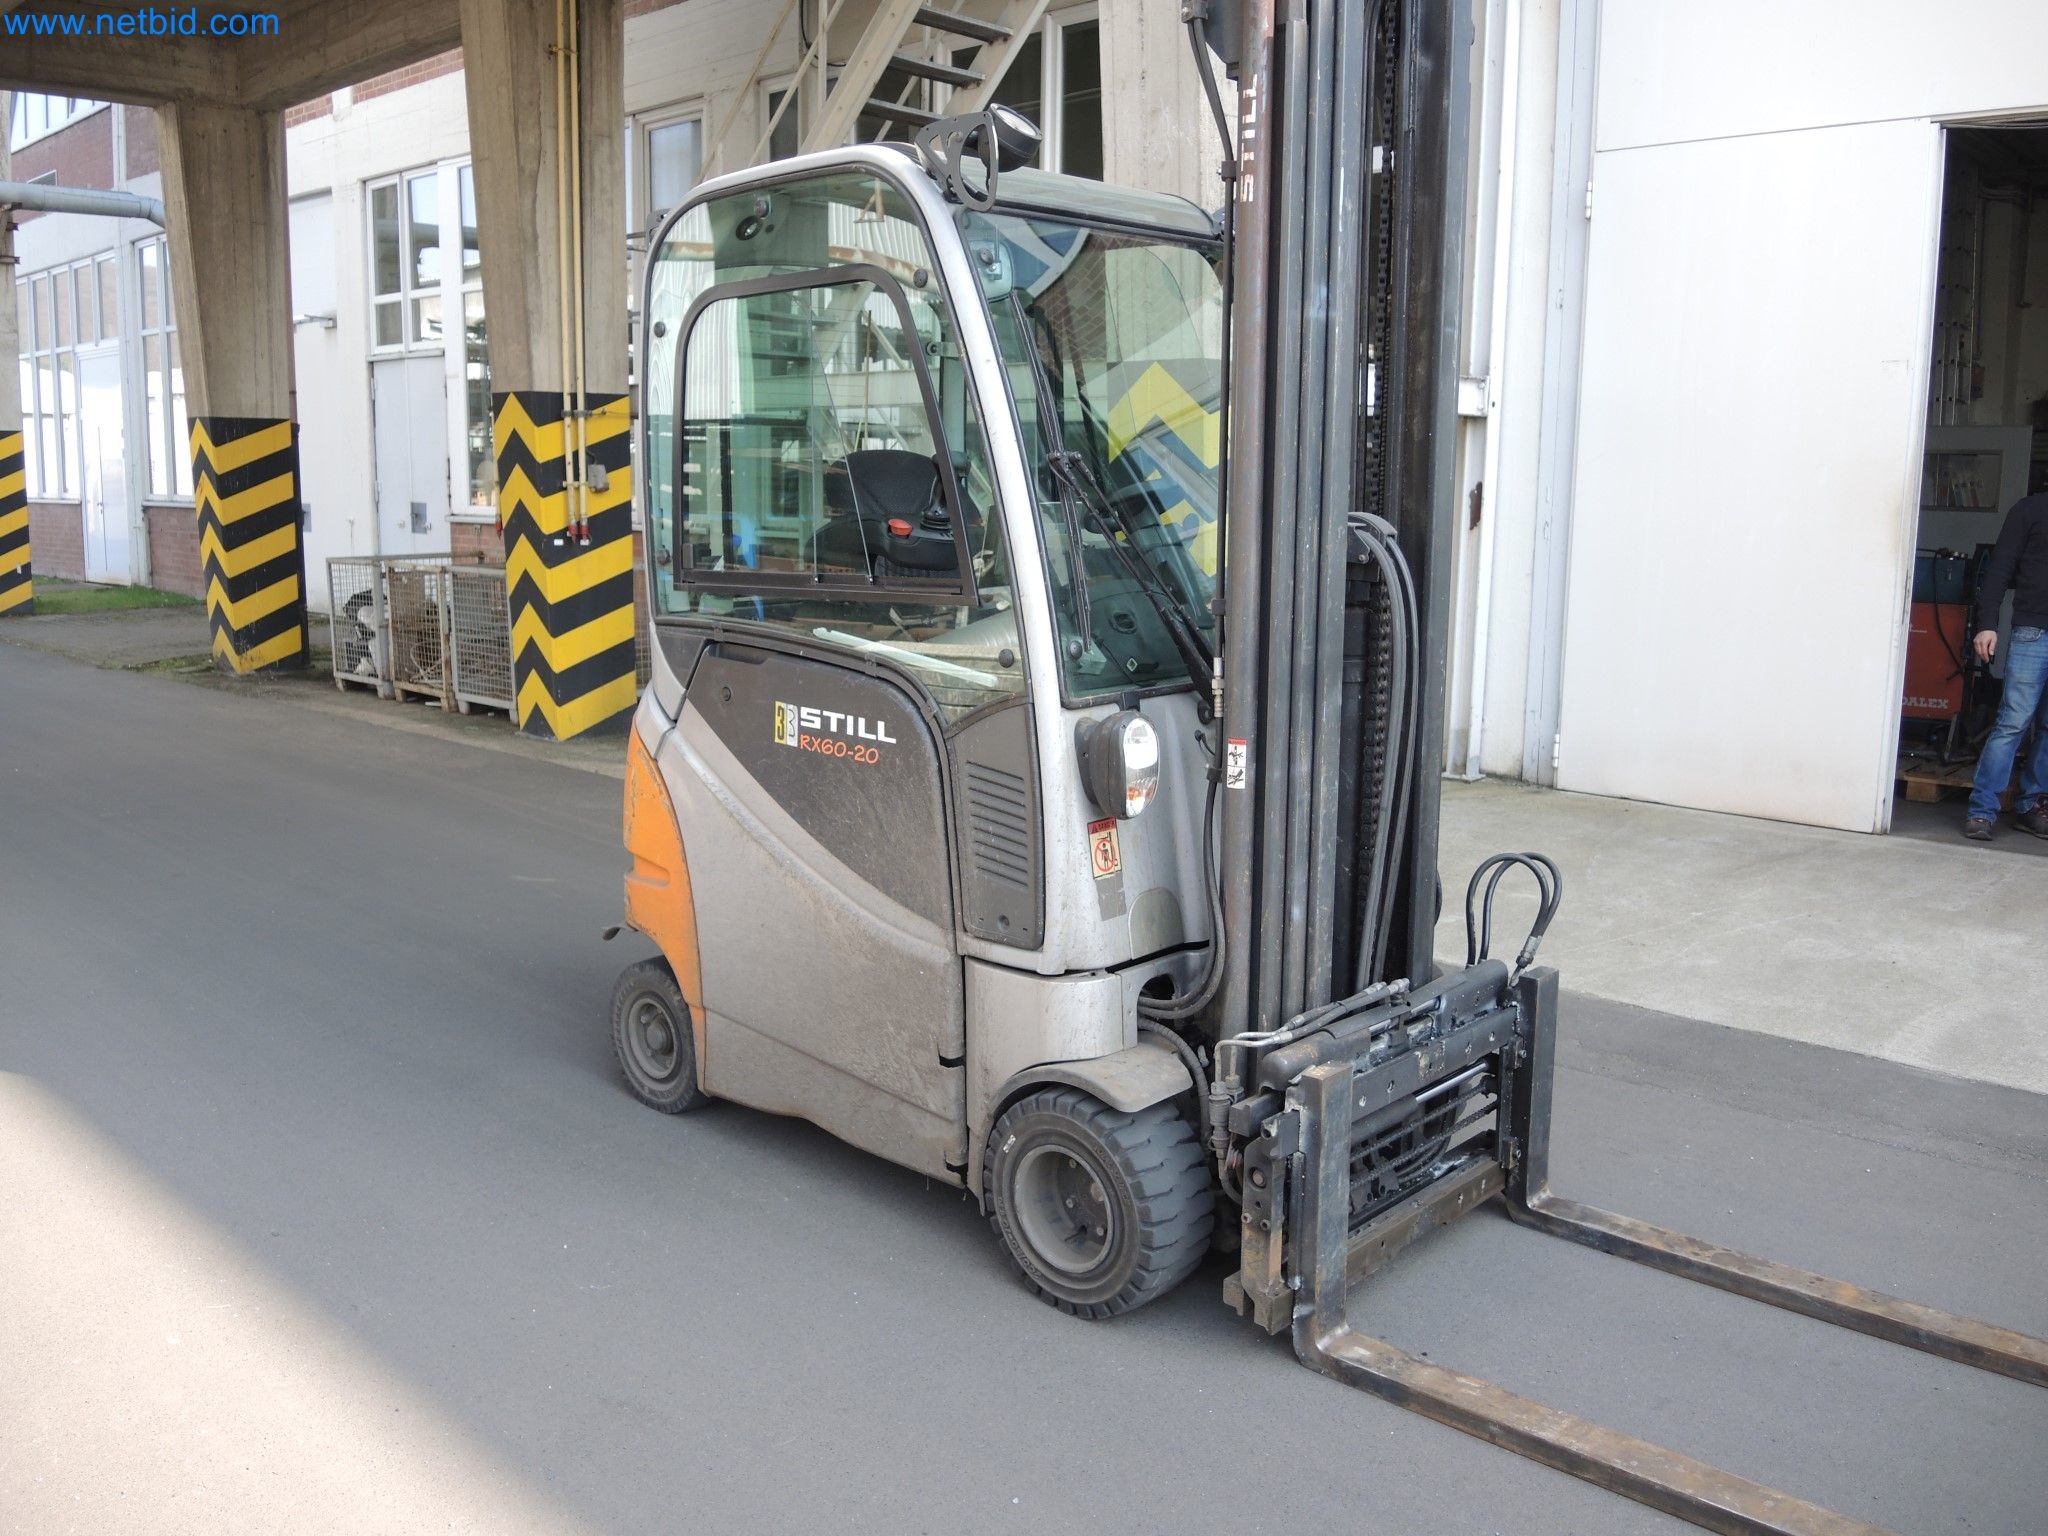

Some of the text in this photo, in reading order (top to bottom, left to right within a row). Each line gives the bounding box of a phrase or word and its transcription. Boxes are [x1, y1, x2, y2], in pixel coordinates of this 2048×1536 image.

[1240, 73, 1257, 203] STILL
[800, 706, 896, 744] STILL
[800, 734, 879, 764] RX60-20
